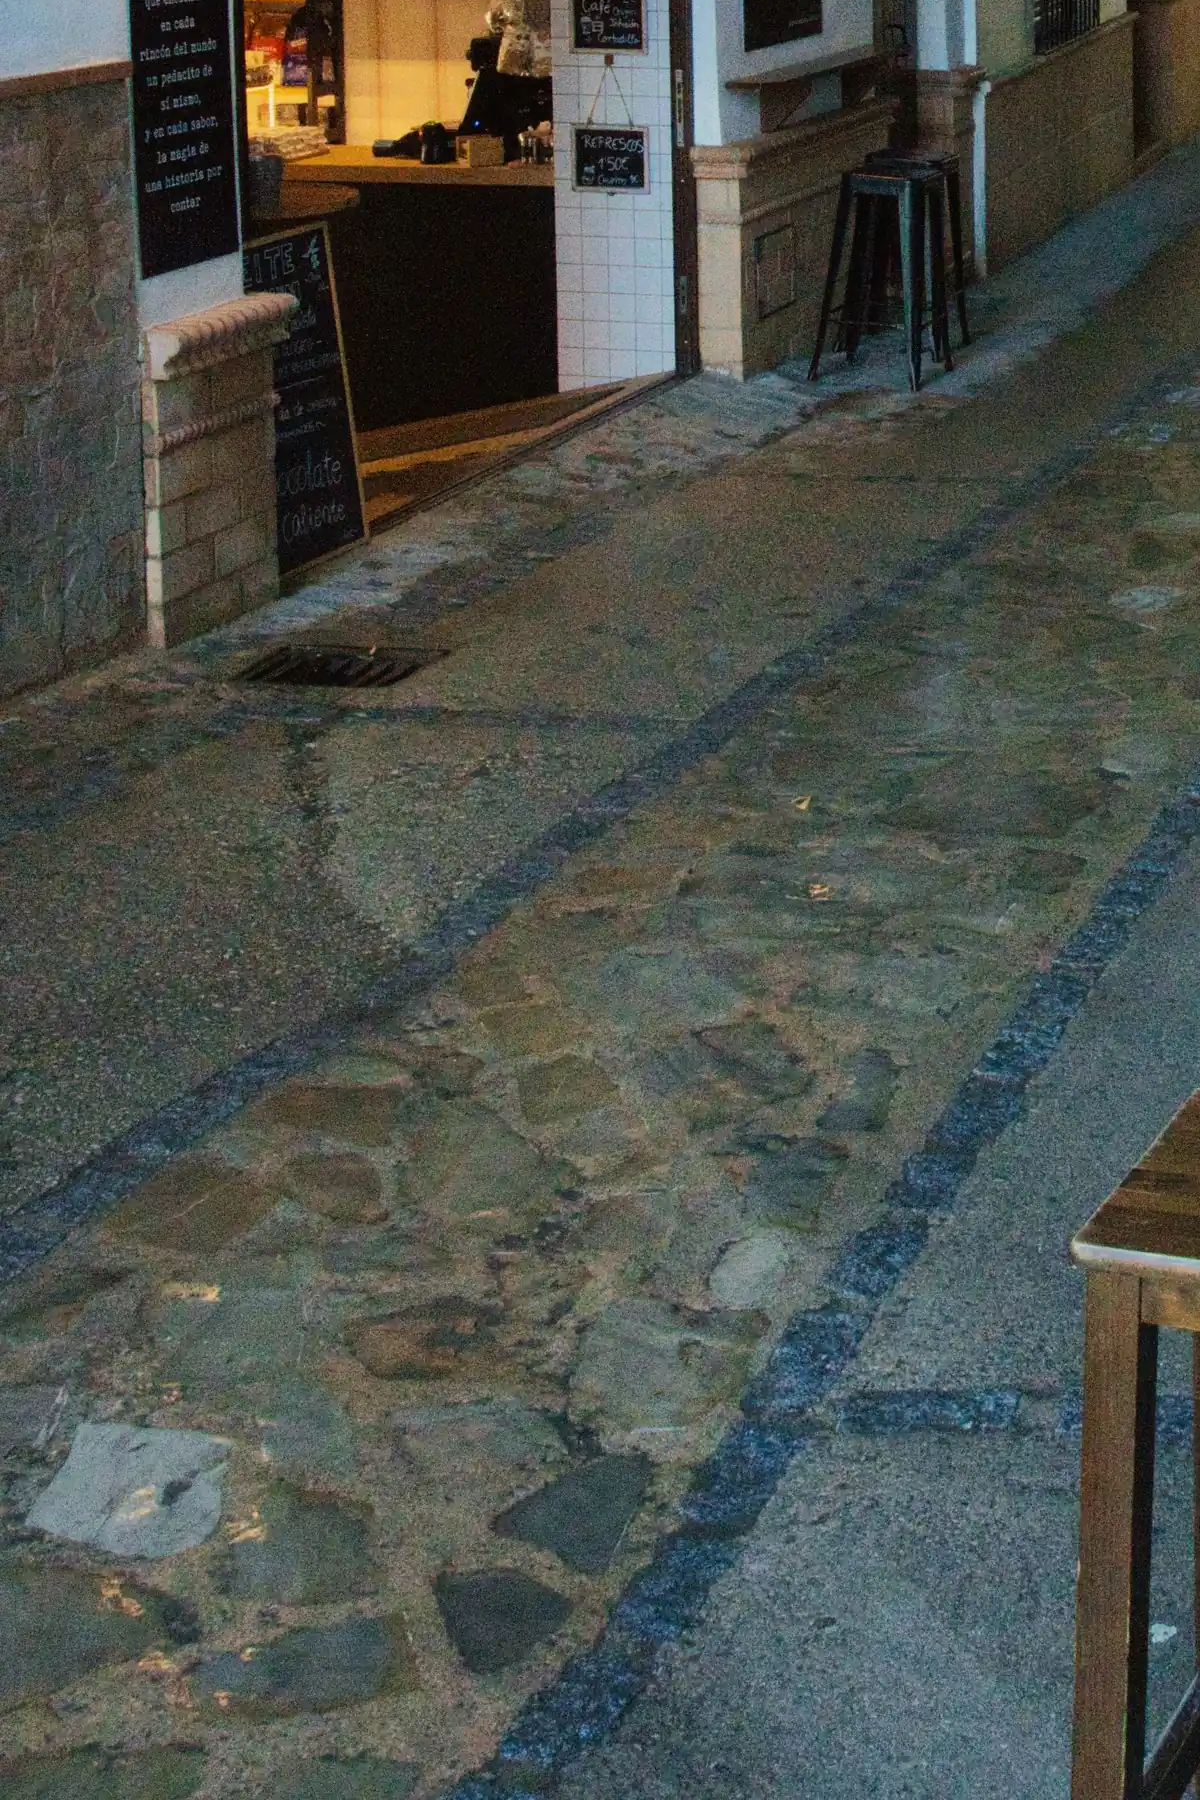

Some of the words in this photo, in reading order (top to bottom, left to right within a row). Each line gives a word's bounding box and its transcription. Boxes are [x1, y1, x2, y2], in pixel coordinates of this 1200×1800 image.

[160, 20, 172, 33] en
[174, 15, 195, 30] cada
[139, 44, 171, 62] rincón
[173, 40, 189, 57] del
[190, 38, 217, 54] mundo
[146, 74, 158, 87] un
[161, 67, 201, 88] pedacito
[202, 64, 213, 78] de
[144, 128, 151, 143] y
[153, 126, 165, 139] en
[166, 122, 189, 137] cada
[191, 114, 219, 131] sabor,
[156, 151, 167, 165] la
[169, 144, 196, 163] magia
[198, 141, 209, 155] de
[580, 134, 645, 154] REFRESCOS
[145, 181, 163, 194] una
[164, 170, 205, 190] historia
[206, 164, 224, 181] por
[170, 194, 201, 214] contar
